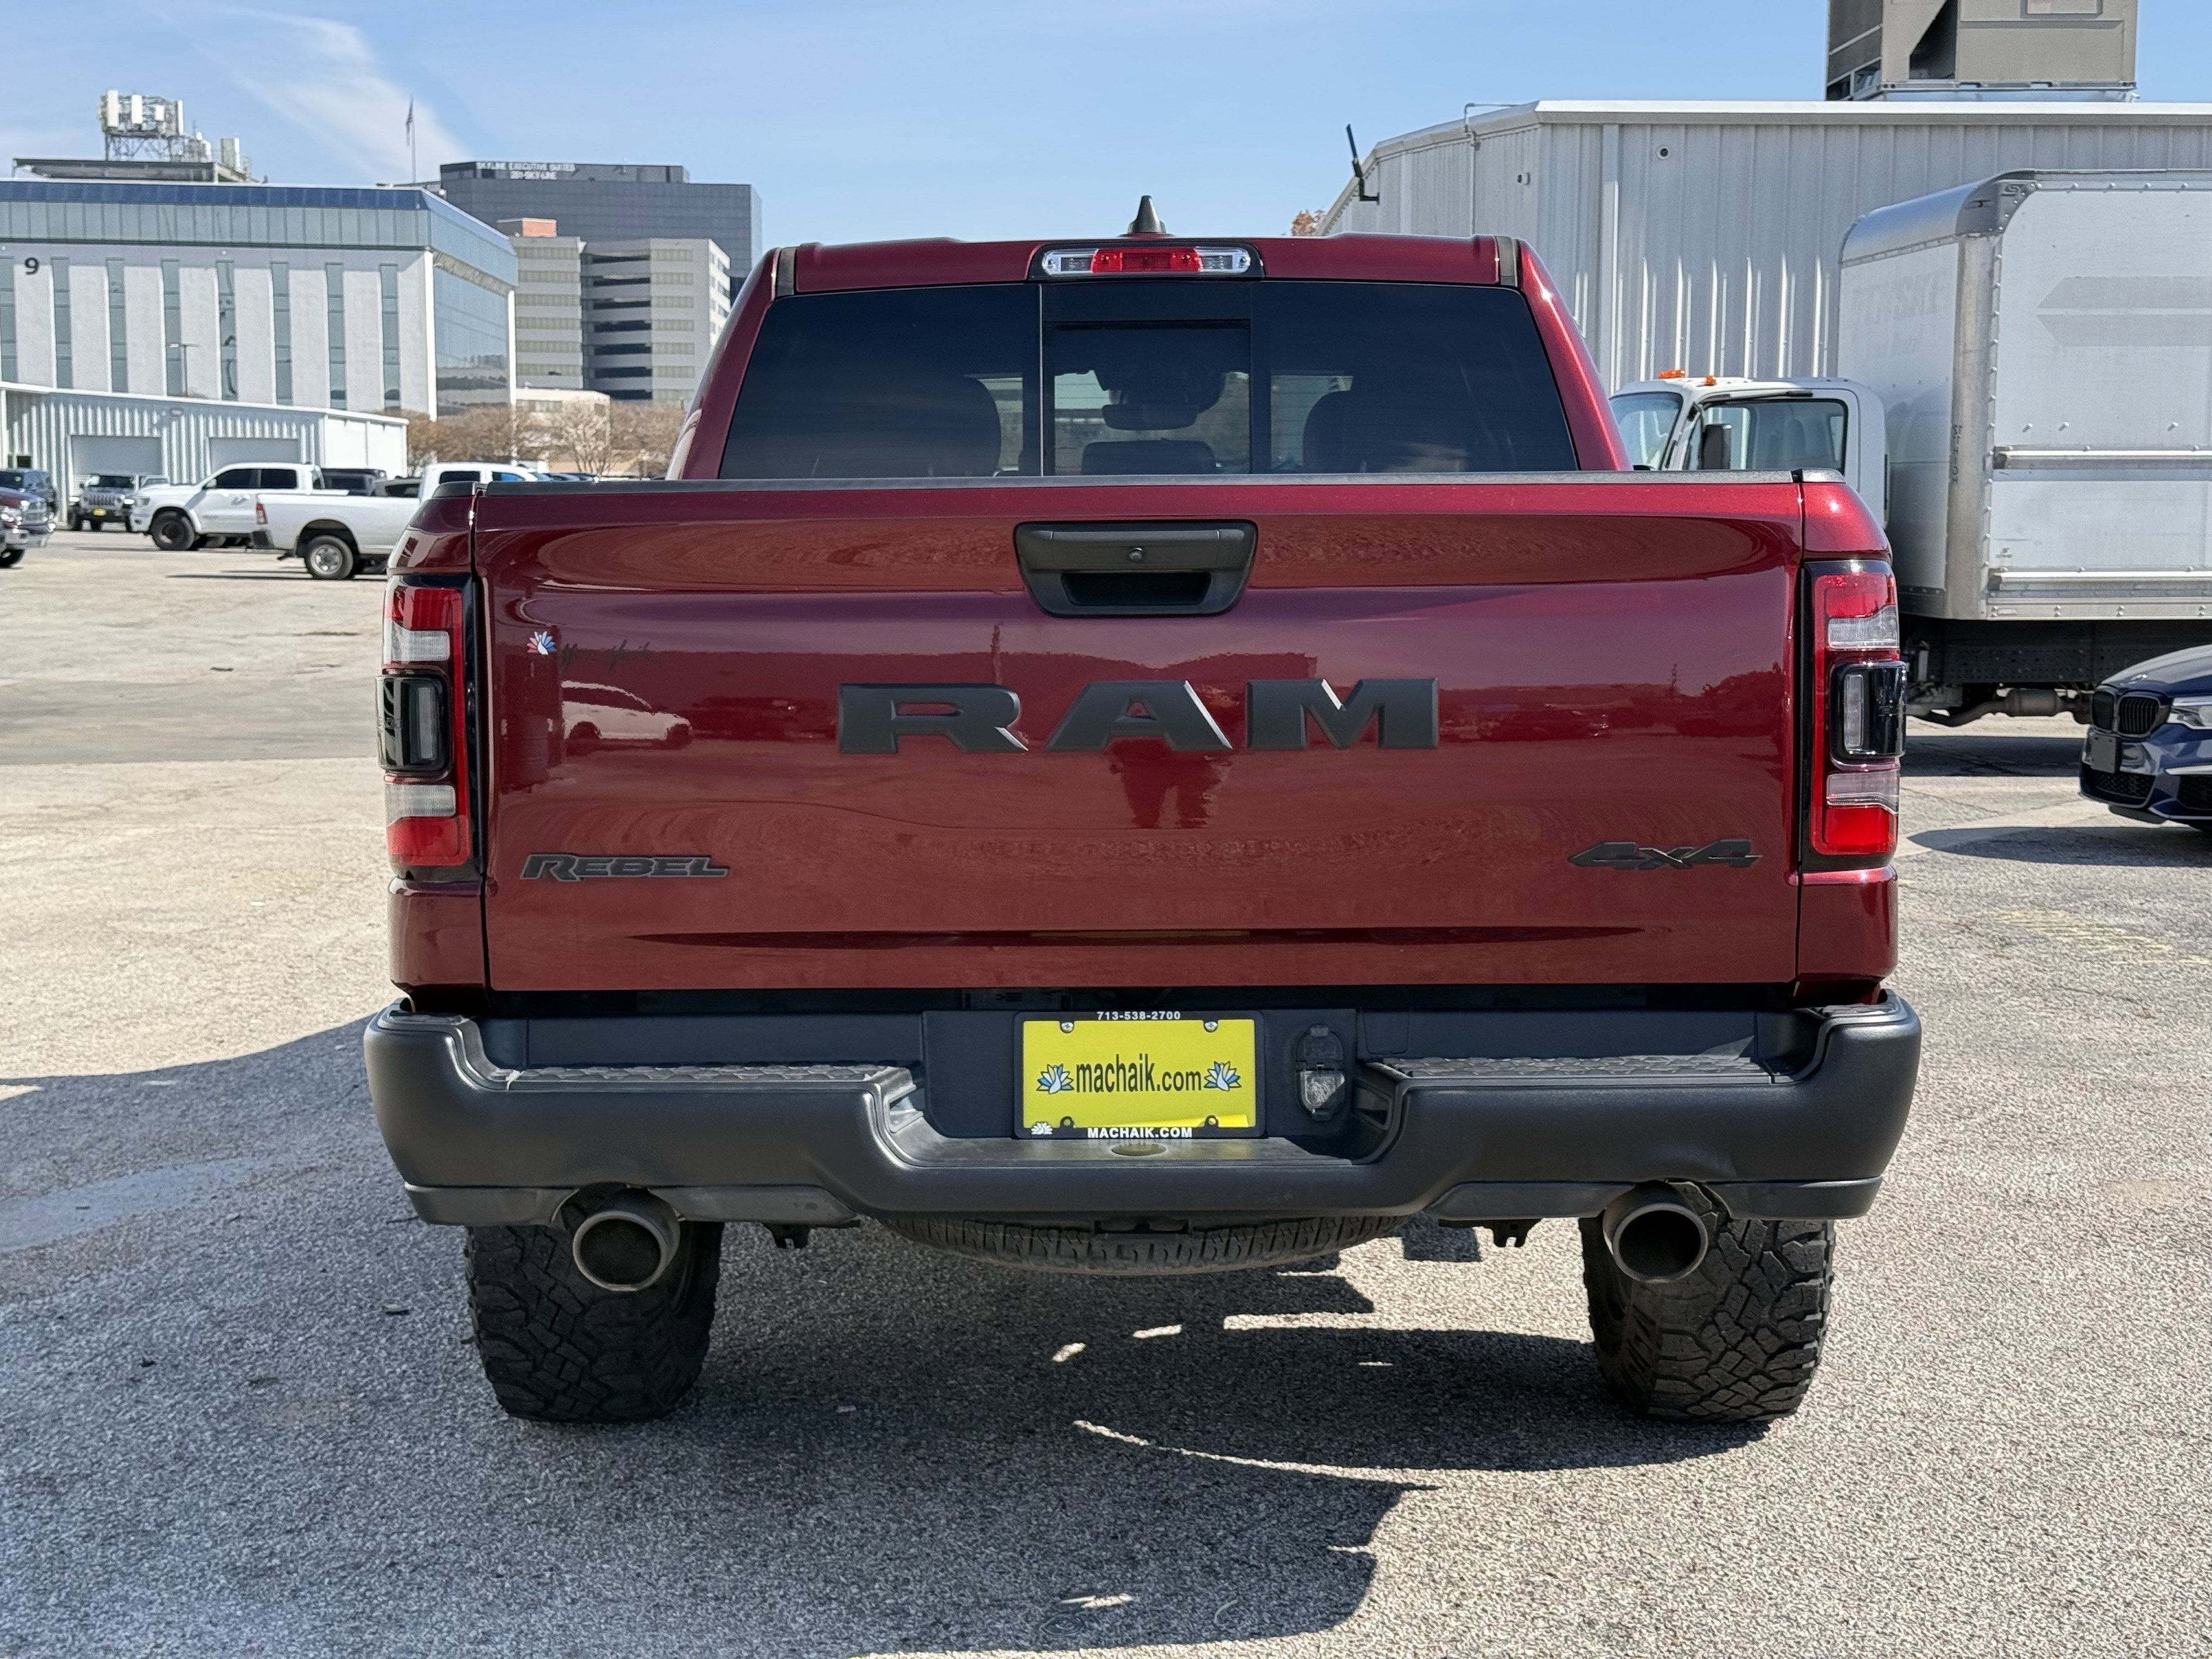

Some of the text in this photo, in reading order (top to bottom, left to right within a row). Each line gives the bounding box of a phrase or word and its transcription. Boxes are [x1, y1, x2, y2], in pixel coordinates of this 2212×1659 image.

[24, 257, 39, 275] 9
[838, 678, 1439, 753] RAM
[520, 853, 730, 882] REBEL
[1097, 1011, 1181, 1020] 713-538-2700
[1076, 1053, 1201, 1092] machaik.com
[1087, 1127, 1193, 1138] MACHAIK.COM
